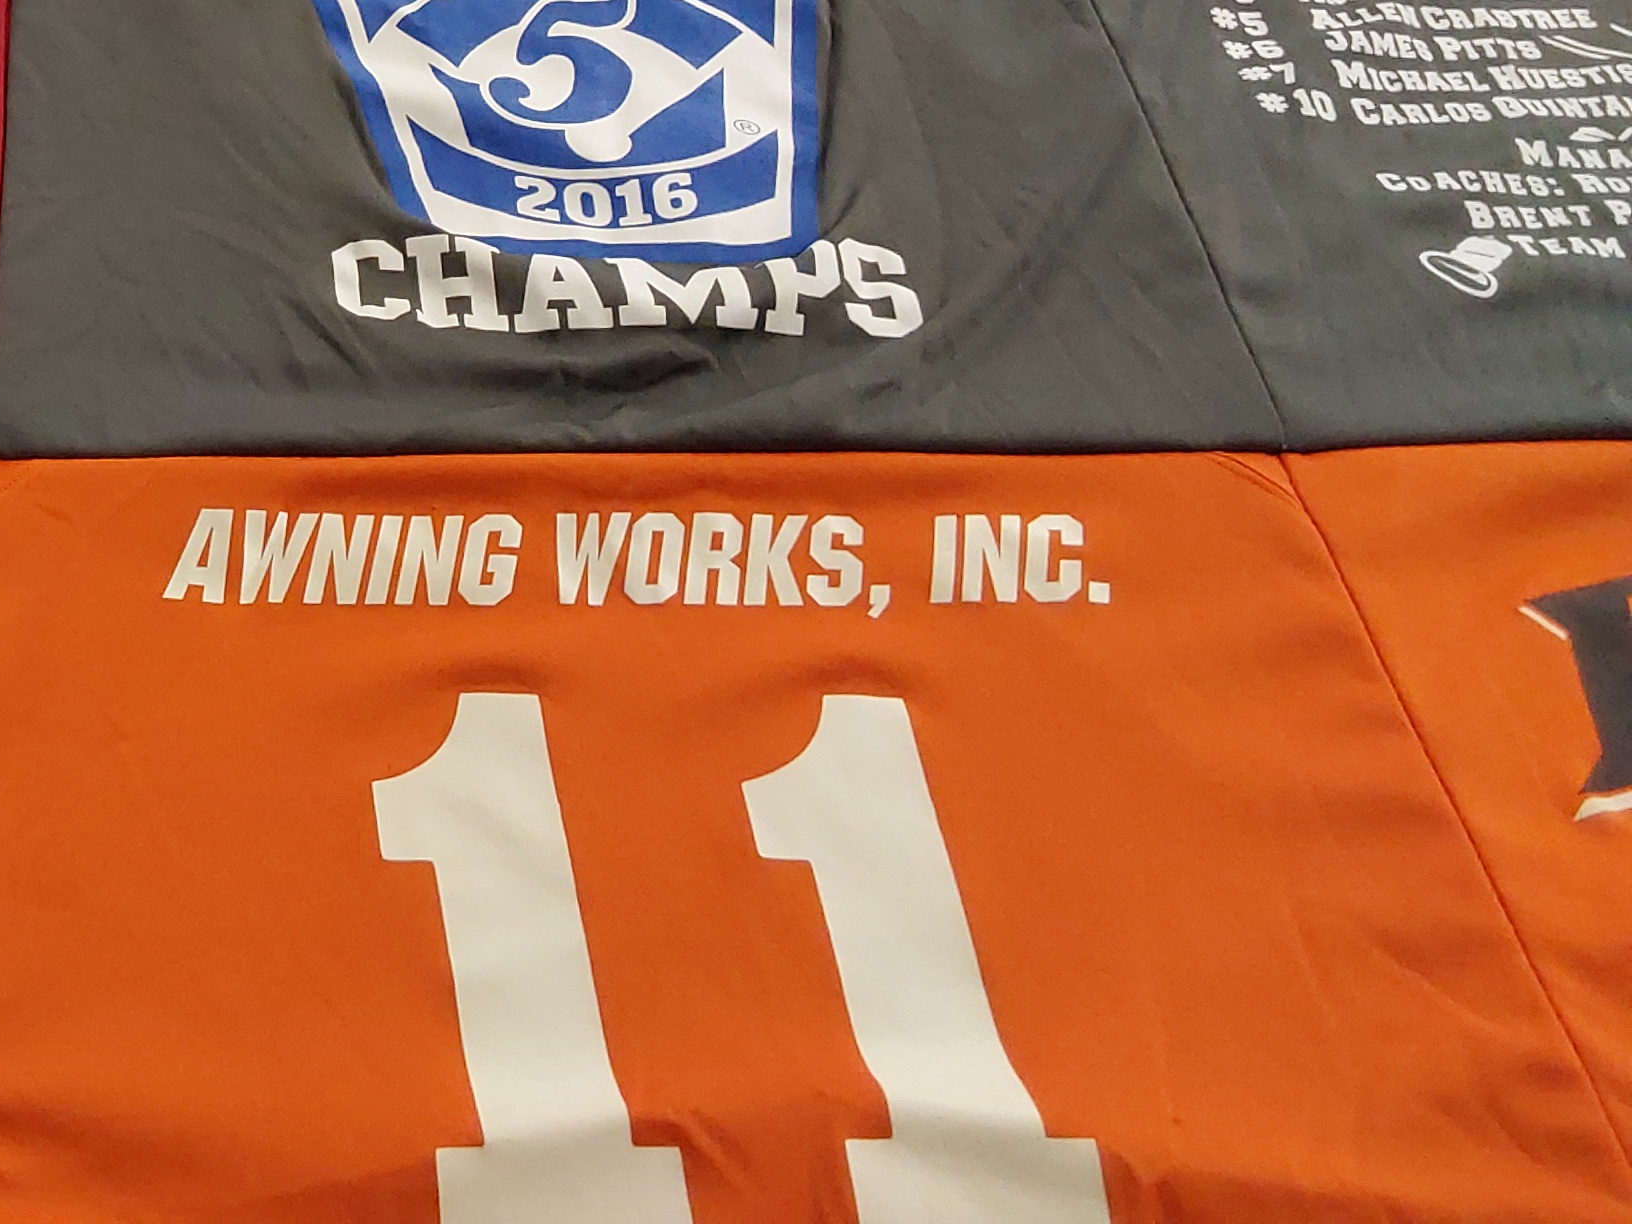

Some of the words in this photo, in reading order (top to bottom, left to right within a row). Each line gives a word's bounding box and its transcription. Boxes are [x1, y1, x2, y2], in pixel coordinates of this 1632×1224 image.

[1210, 5, 1270, 37] #5
[1310, 1, 1422, 31] ALLEN
[1421, 6, 1598, 30] CRABTREE
[1222, 39, 1284, 61] #6
[1324, 29, 1434, 63] JAMES
[1431, 35, 1542, 61] PITTS
[1237, 61, 1297, 85] #7
[1330, 58, 1491, 93] MICHAEL
[1487, 62, 1632, 91] HUESTIS
[1350, 96, 1492, 126] CARLOS
[1514, 137, 1632, 170] MANA
[514, 172, 700, 228] 2016
[1376, 169, 1566, 197] COACHES:
[1570, 173, 1632, 194] RO
[1463, 199, 1592, 230] BRENT
[1506, 234, 1627, 260] TEAM
[330, 234, 924, 339] CHAMPS
[163, 507, 521, 607] AWNING
[554, 511, 890, 620] WORKS,
[928, 512, 1112, 605] INC.
[370, 690, 1114, 1224] 11
